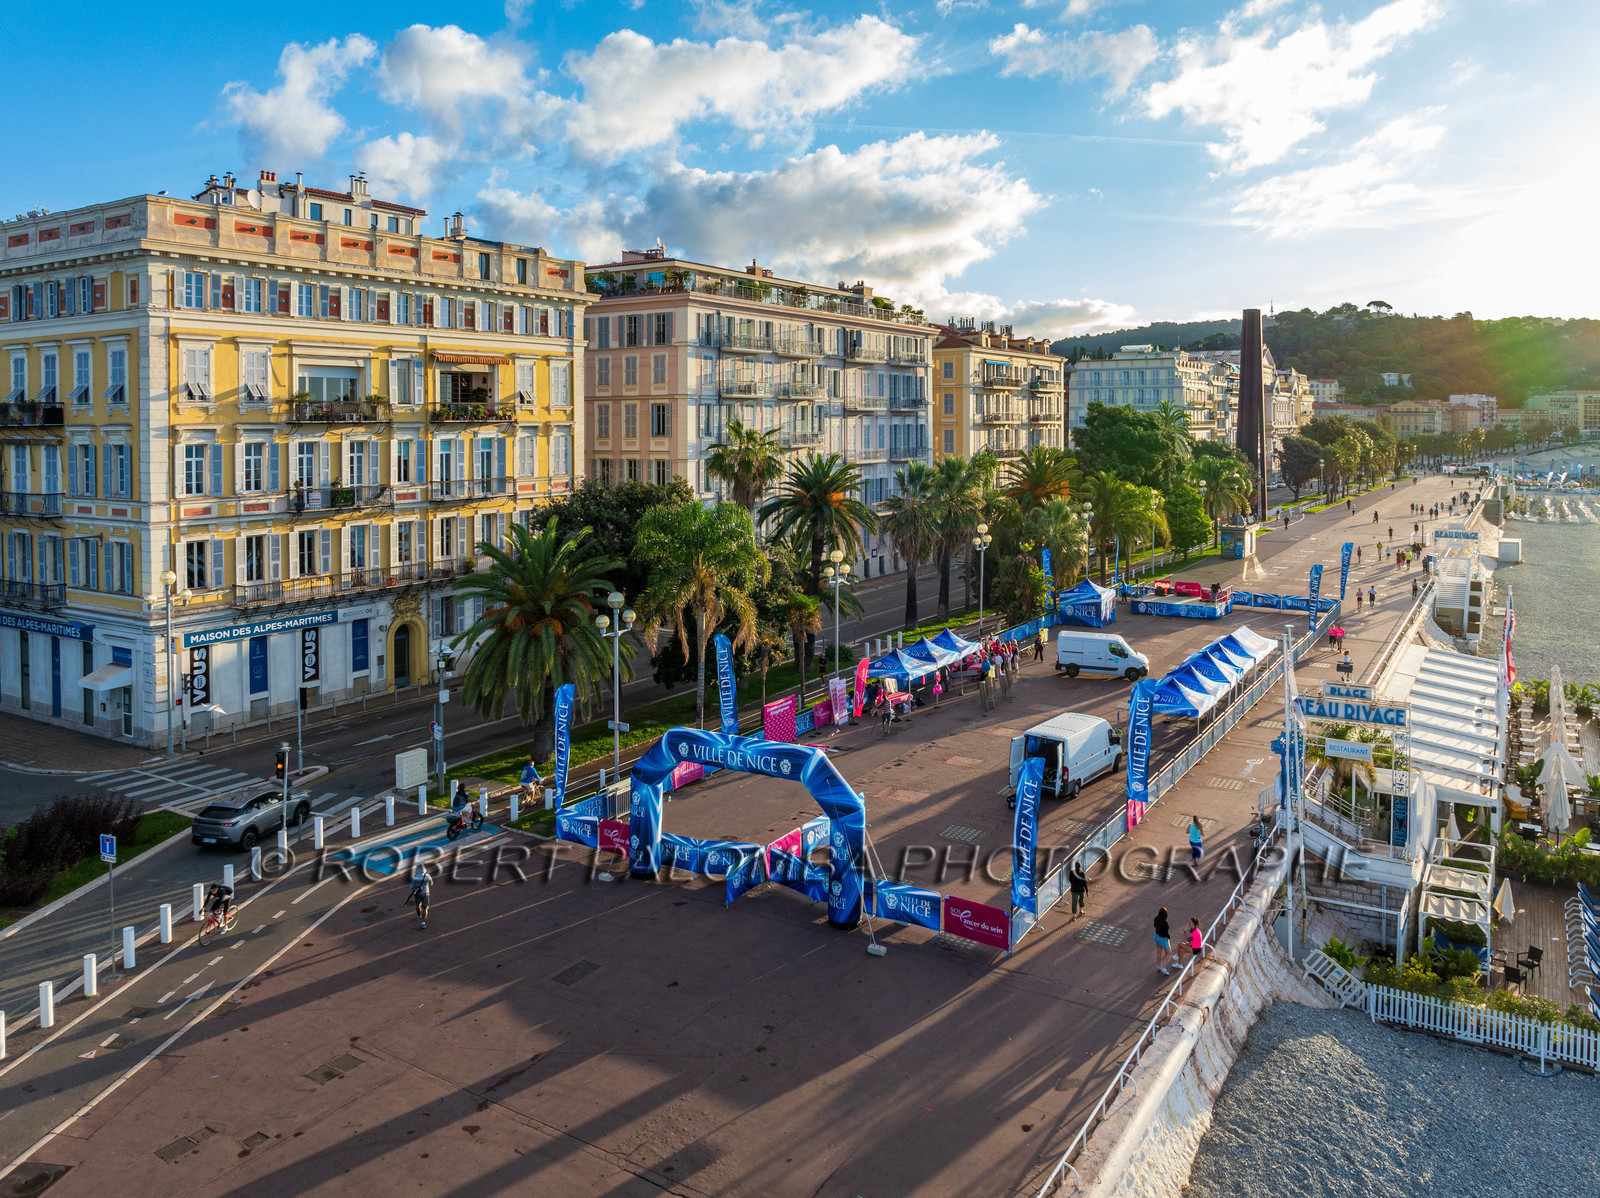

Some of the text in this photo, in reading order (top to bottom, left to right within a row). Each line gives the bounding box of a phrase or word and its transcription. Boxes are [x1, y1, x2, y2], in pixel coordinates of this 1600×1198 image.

[1434, 530, 1478, 540] BEAU RIVAGE
[1075, 609, 1096, 617] NICE
[2, 616, 80, 638] DES ALPES-MARITIMES
[190, 614, 333, 644] MAISON DES ALPES-MARITIMES
[305, 629, 316, 679] VOUS
[193, 648, 207, 703] VOUS
[718, 648, 734, 717] VILLE DE NICE
[1330, 686, 1366, 698] PLACE
[558, 702, 569, 734] NICE
[1298, 698, 1405, 726] BEAU RIVAGE
[558, 735, 566, 751] DE
[1132, 697, 1150, 779] VILLE DE NICE
[1329, 744, 1368, 755] RESTAURANT
[693, 744, 777, 773] VILLE DE NICE
[571, 820, 584, 828] VILLE
[571, 826, 592, 838] NICE
[1019, 778, 1038, 882] VILLE DE NICE
[665, 848, 690, 861] NICE
[900, 895, 931, 908] VILLE DE
[901, 902, 931, 918] NICE
[990, 926, 1003, 934] sein
